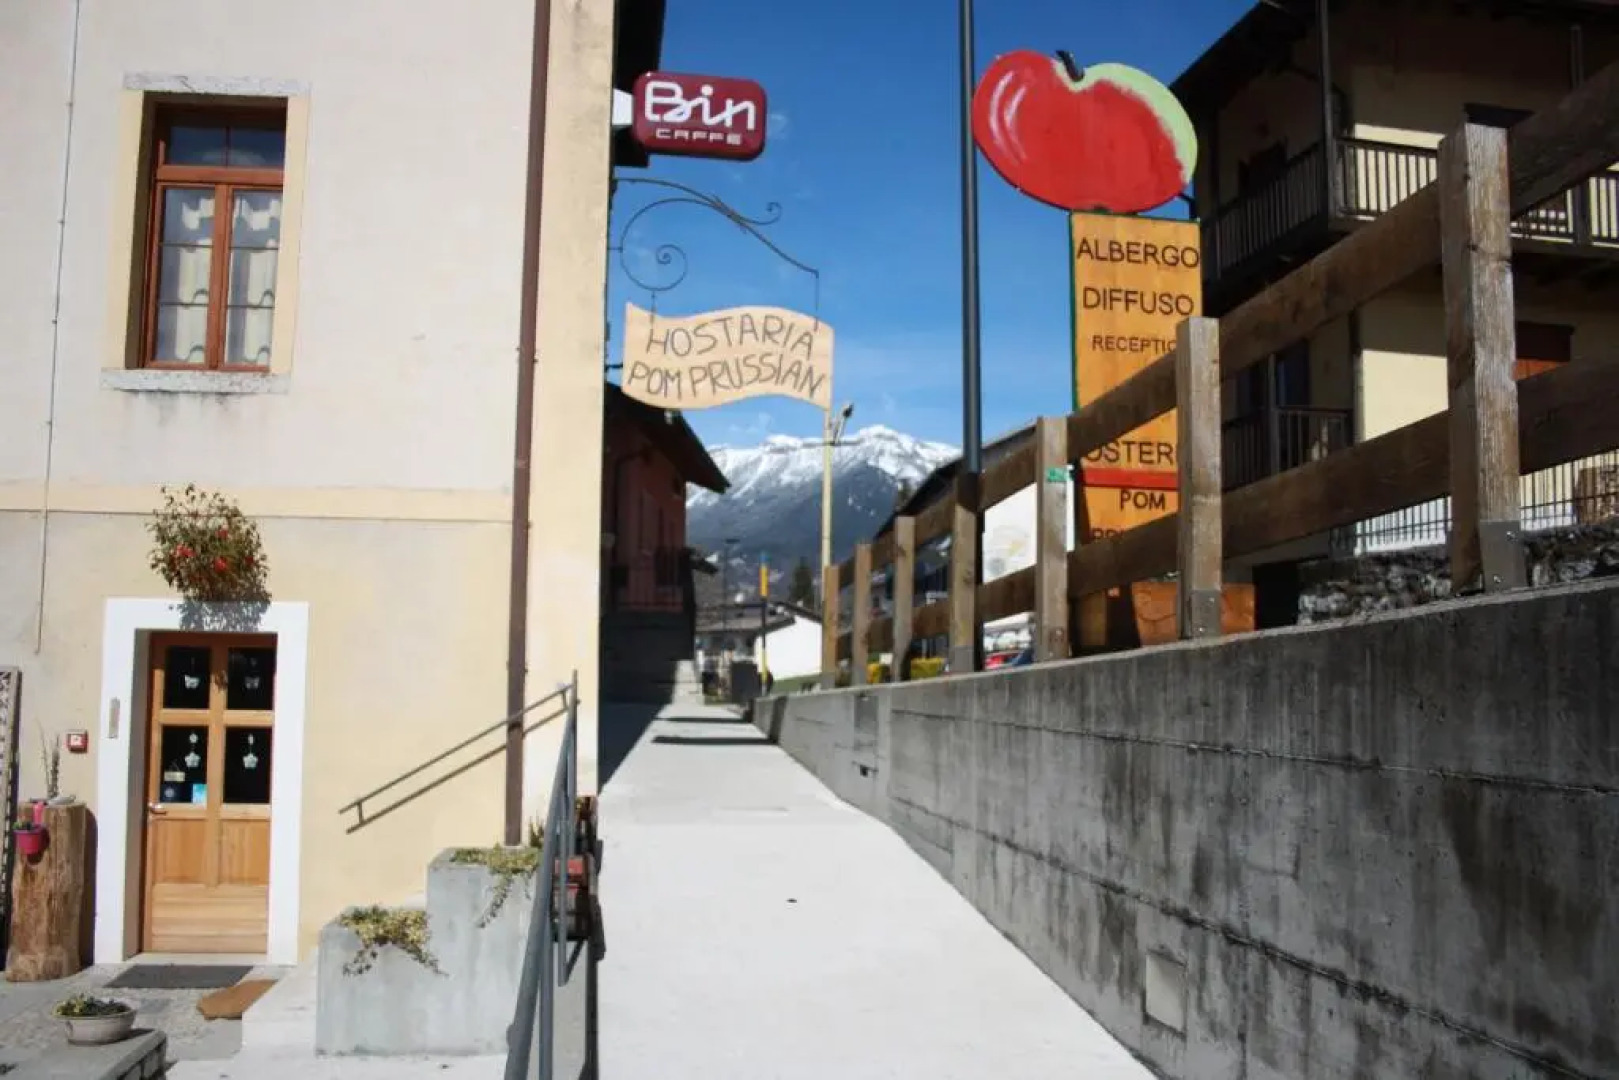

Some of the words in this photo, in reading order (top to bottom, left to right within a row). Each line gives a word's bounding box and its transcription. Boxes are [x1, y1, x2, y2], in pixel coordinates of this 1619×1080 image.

[645, 81, 756, 131] Bin
[1077, 236, 1199, 268] ALBERGO
[1083, 285, 1194, 315] DIFFUSO
[646, 313, 814, 360] HOSTARIA
[628, 360, 682, 399] POM
[689, 353, 825, 398] PRUSSIAN
[1120, 489, 1166, 511] POM
